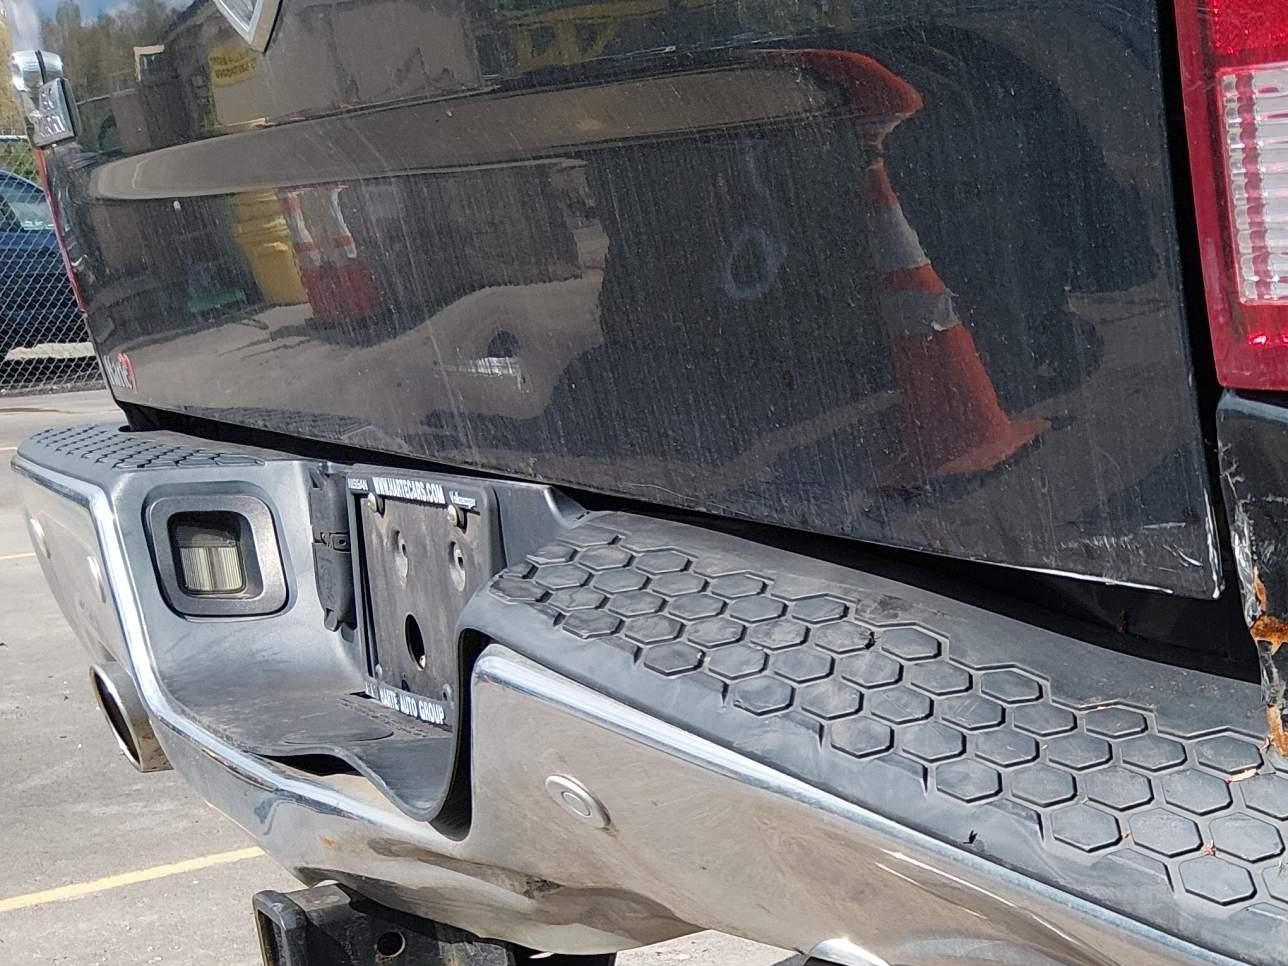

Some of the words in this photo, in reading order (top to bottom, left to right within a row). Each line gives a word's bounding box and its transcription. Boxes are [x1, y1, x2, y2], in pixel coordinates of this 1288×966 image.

[372, 476, 446, 505] WWW.HARTECARS.COM
[379, 686, 400, 711] HARTE
[400, 694, 418, 717] AUTO
[418, 700, 445, 725] GROUP
